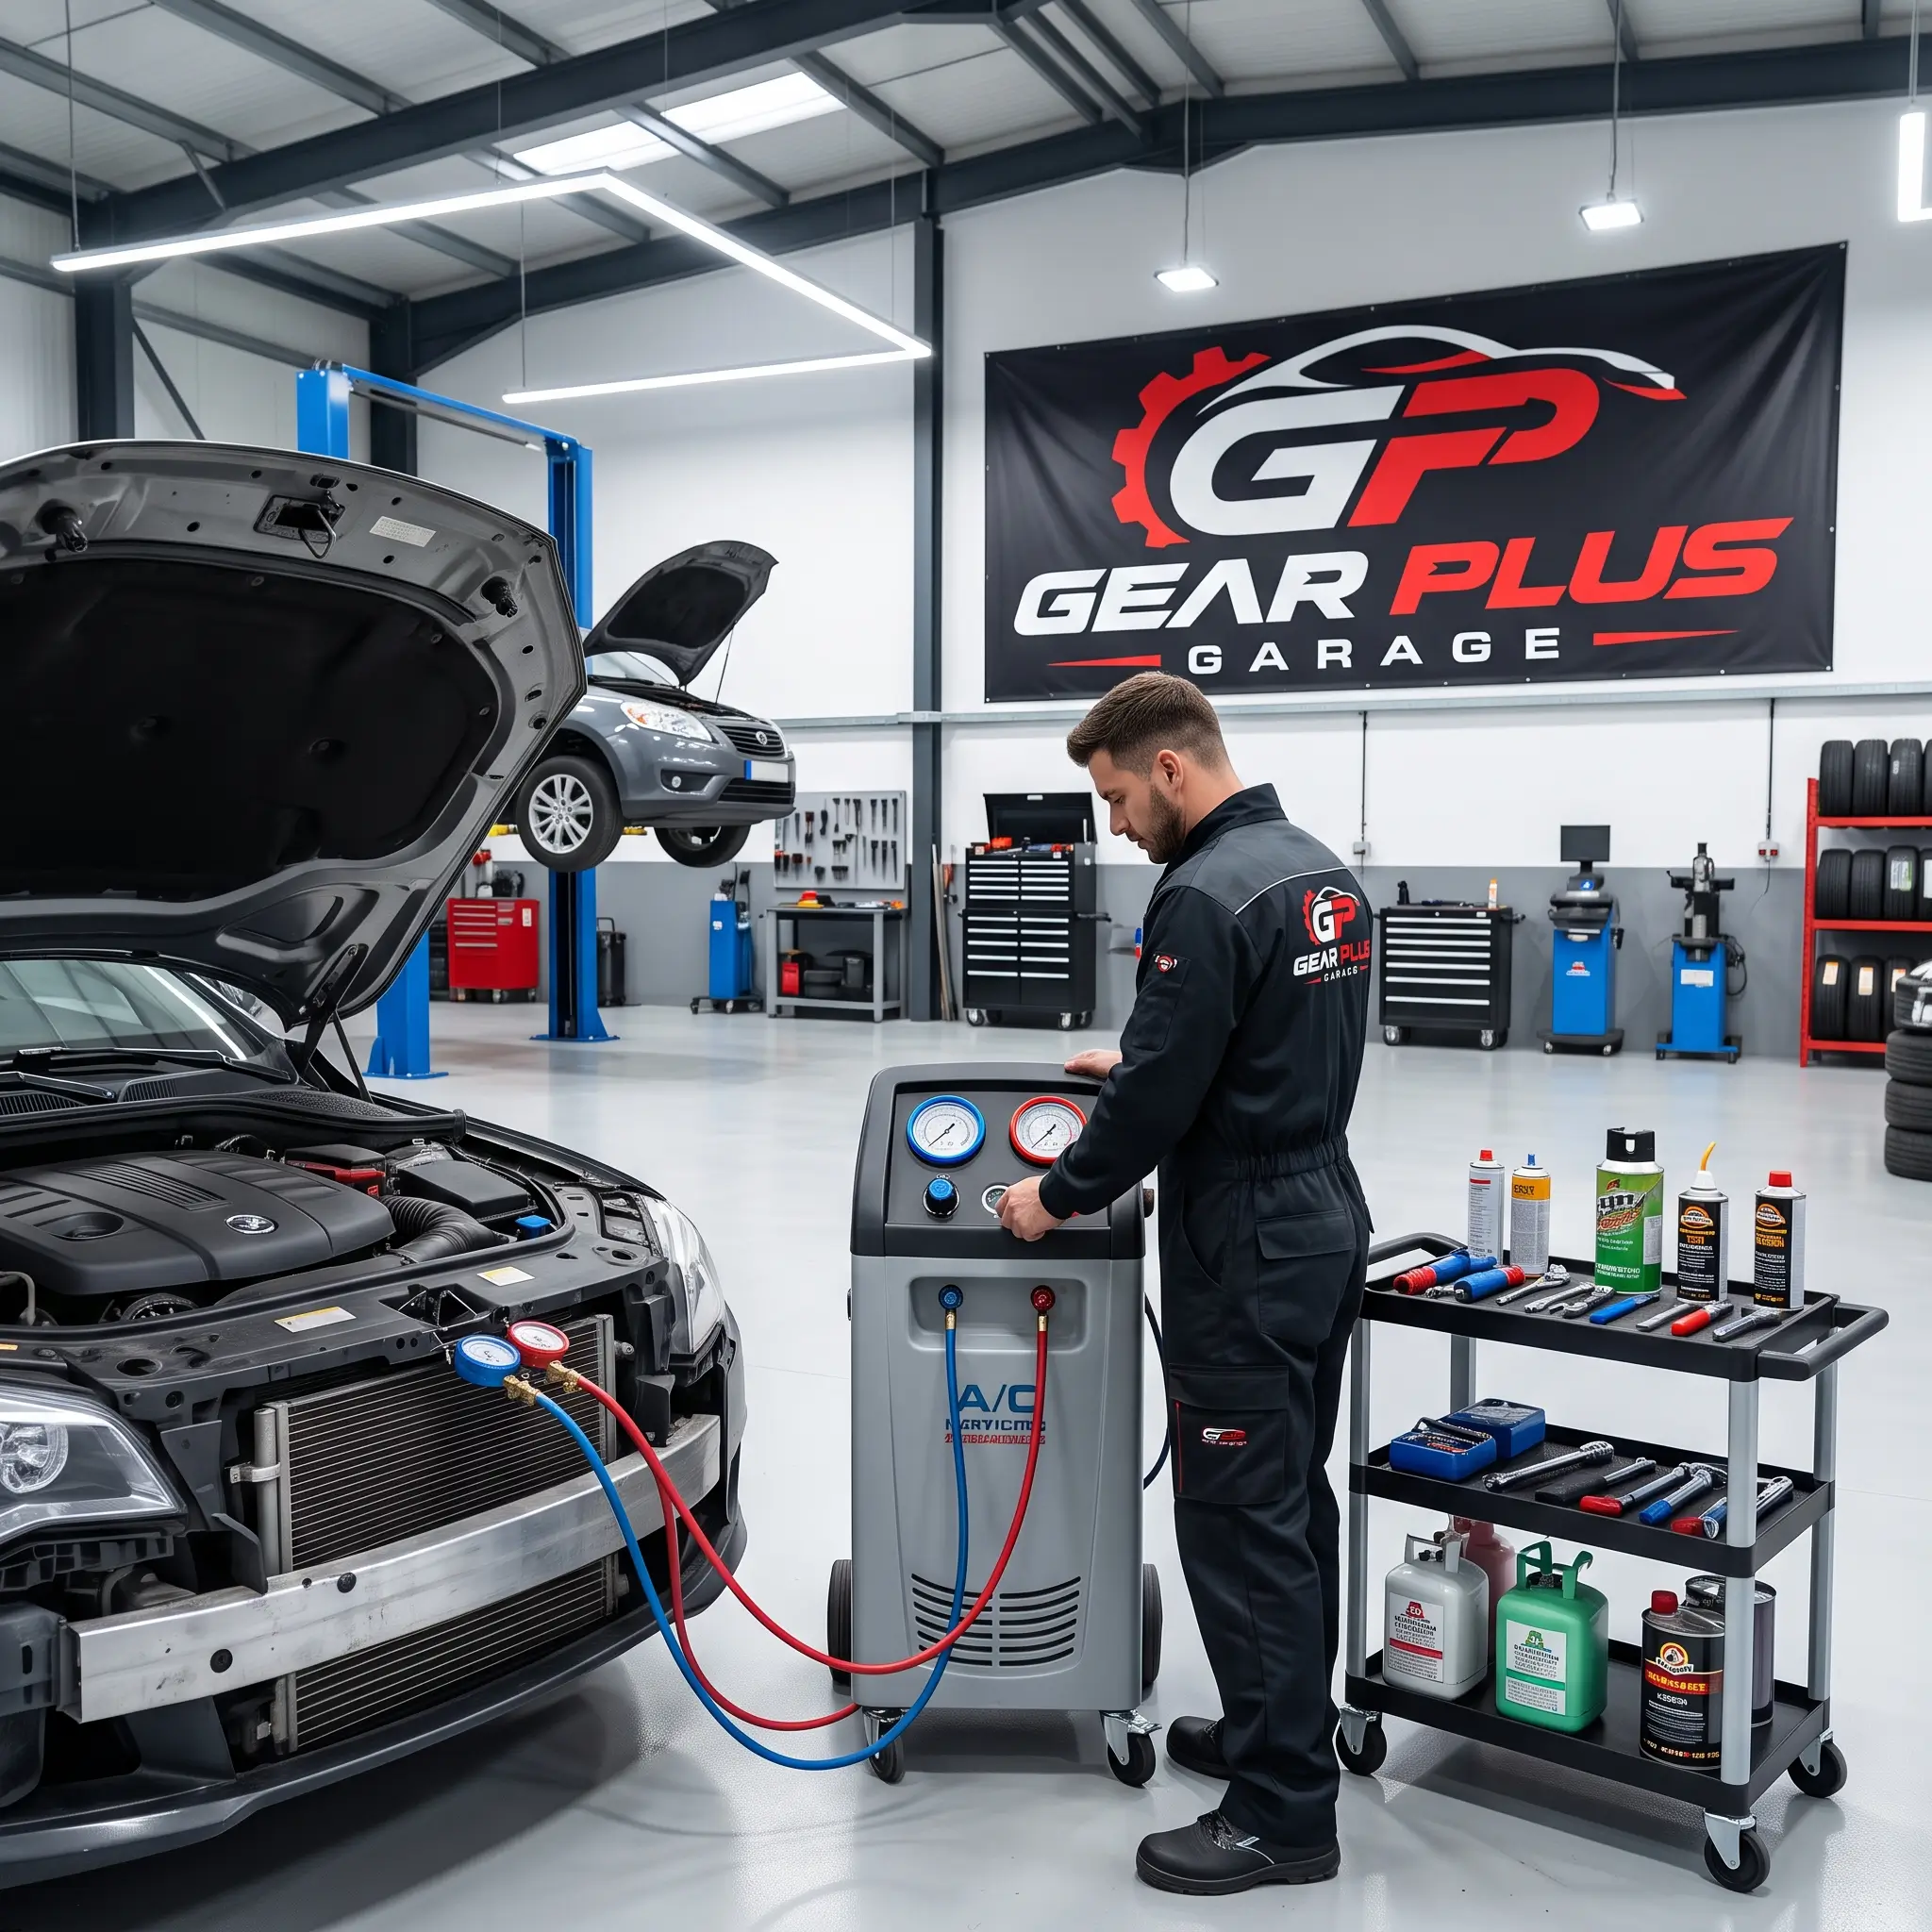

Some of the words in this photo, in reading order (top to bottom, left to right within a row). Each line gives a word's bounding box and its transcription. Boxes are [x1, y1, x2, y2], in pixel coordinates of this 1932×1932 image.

[1170, 369, 1600, 535] GP
[1014, 551, 1369, 636] GEAR
[1389, 518, 1794, 616] PLUS
[1188, 627, 1560, 675] GARAGE
[1293, 946, 1339, 976] GEAR
